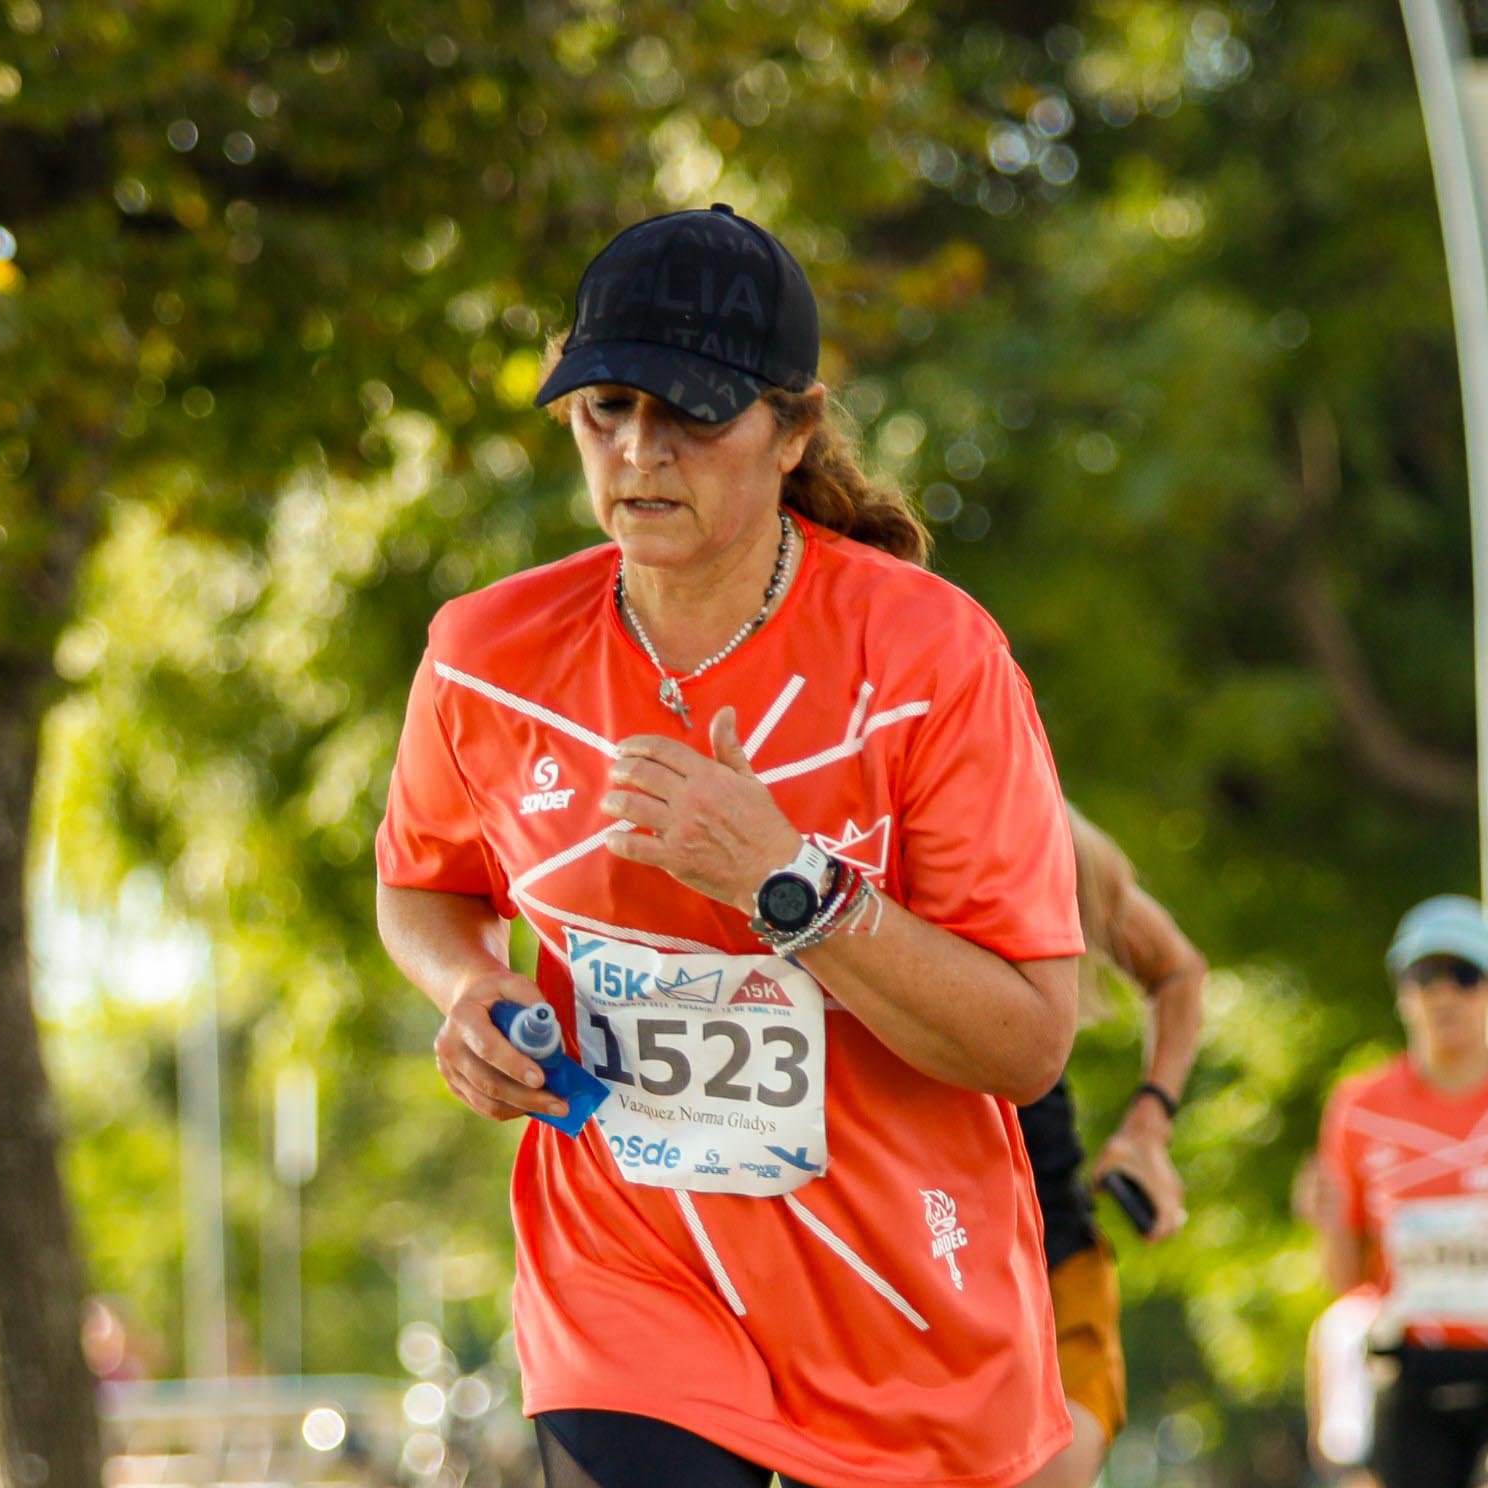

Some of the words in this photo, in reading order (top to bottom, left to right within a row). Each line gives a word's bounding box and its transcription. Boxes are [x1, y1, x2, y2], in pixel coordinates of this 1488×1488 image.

[589, 958, 654, 1001] 15K
[740, 983, 779, 1000] 15K
[590, 1013, 810, 1108] 1523
[619, 1094, 675, 1120] Vazquez
[680, 1106, 724, 1126] Norma
[727, 1111, 777, 1135] Gladys
[609, 1135, 682, 1169] osde
[931, 1227, 969, 1259] ARDEC
